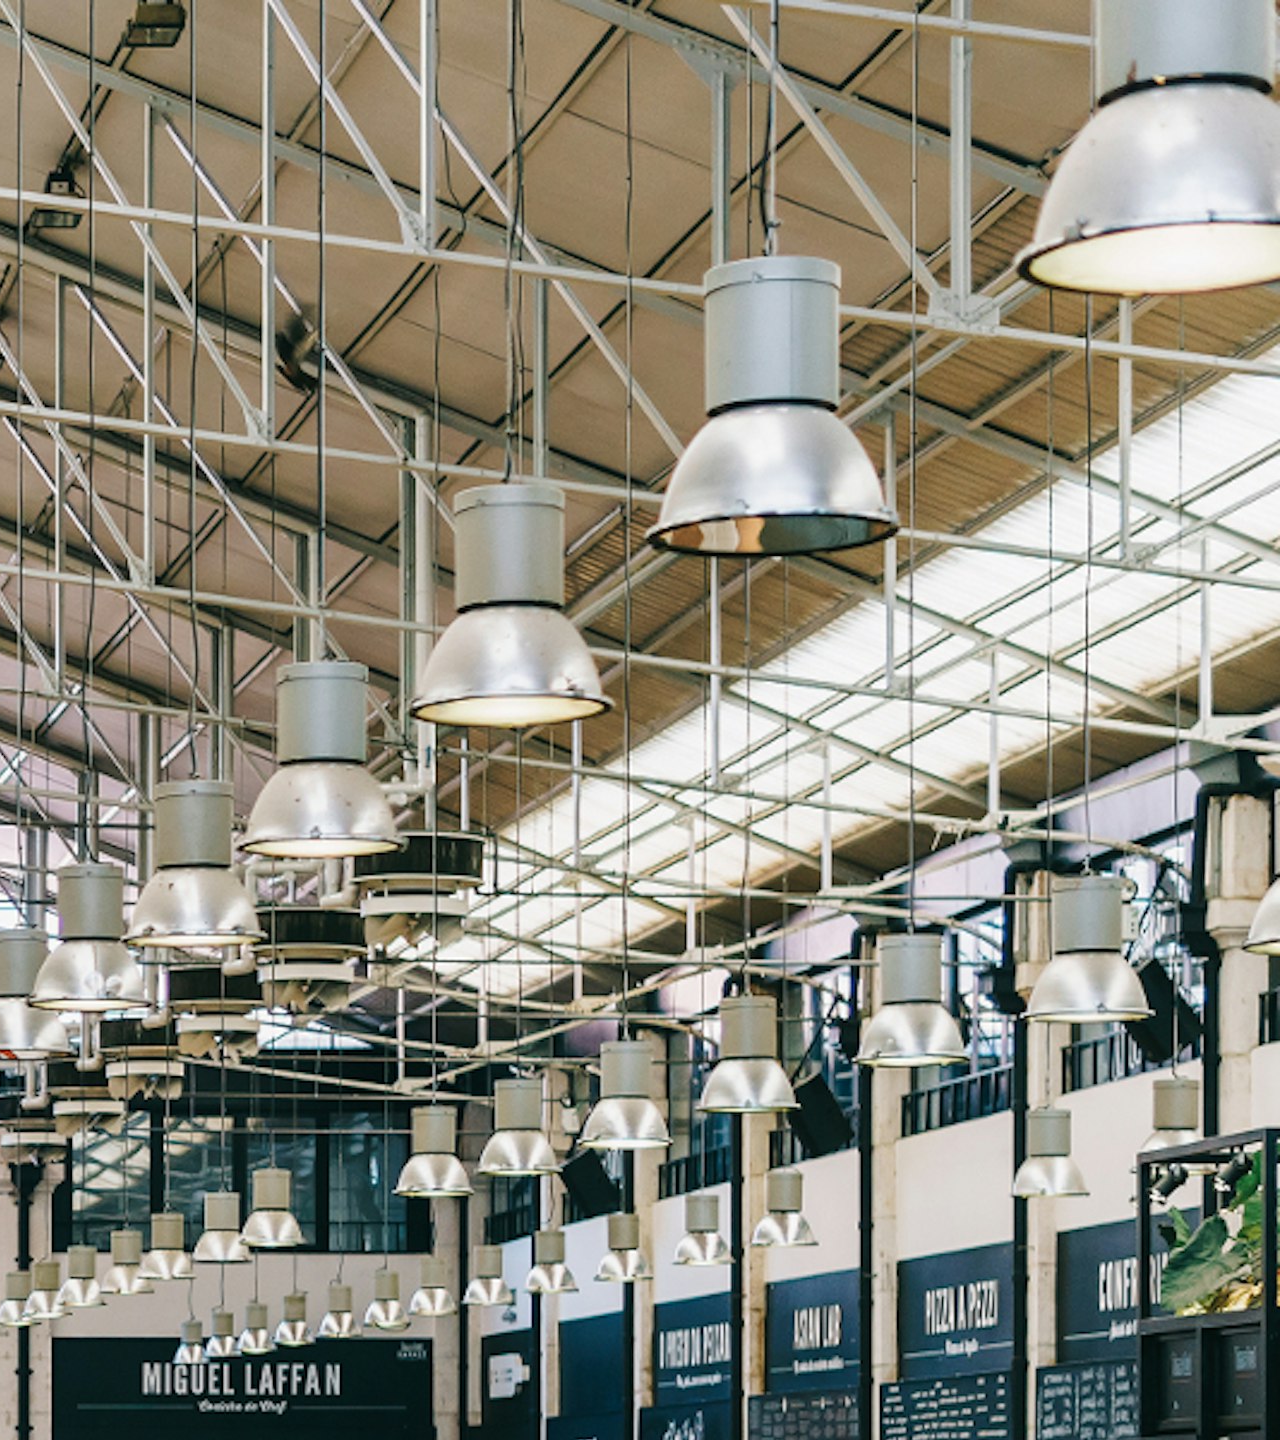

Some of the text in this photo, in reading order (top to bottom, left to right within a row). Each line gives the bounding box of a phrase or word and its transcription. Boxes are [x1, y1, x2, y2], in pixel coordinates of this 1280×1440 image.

[925, 1287, 955, 1336] PIZZA
[956, 1284, 966, 1332] A
[142, 1362, 342, 1396] MIGUEL LAFFAN
